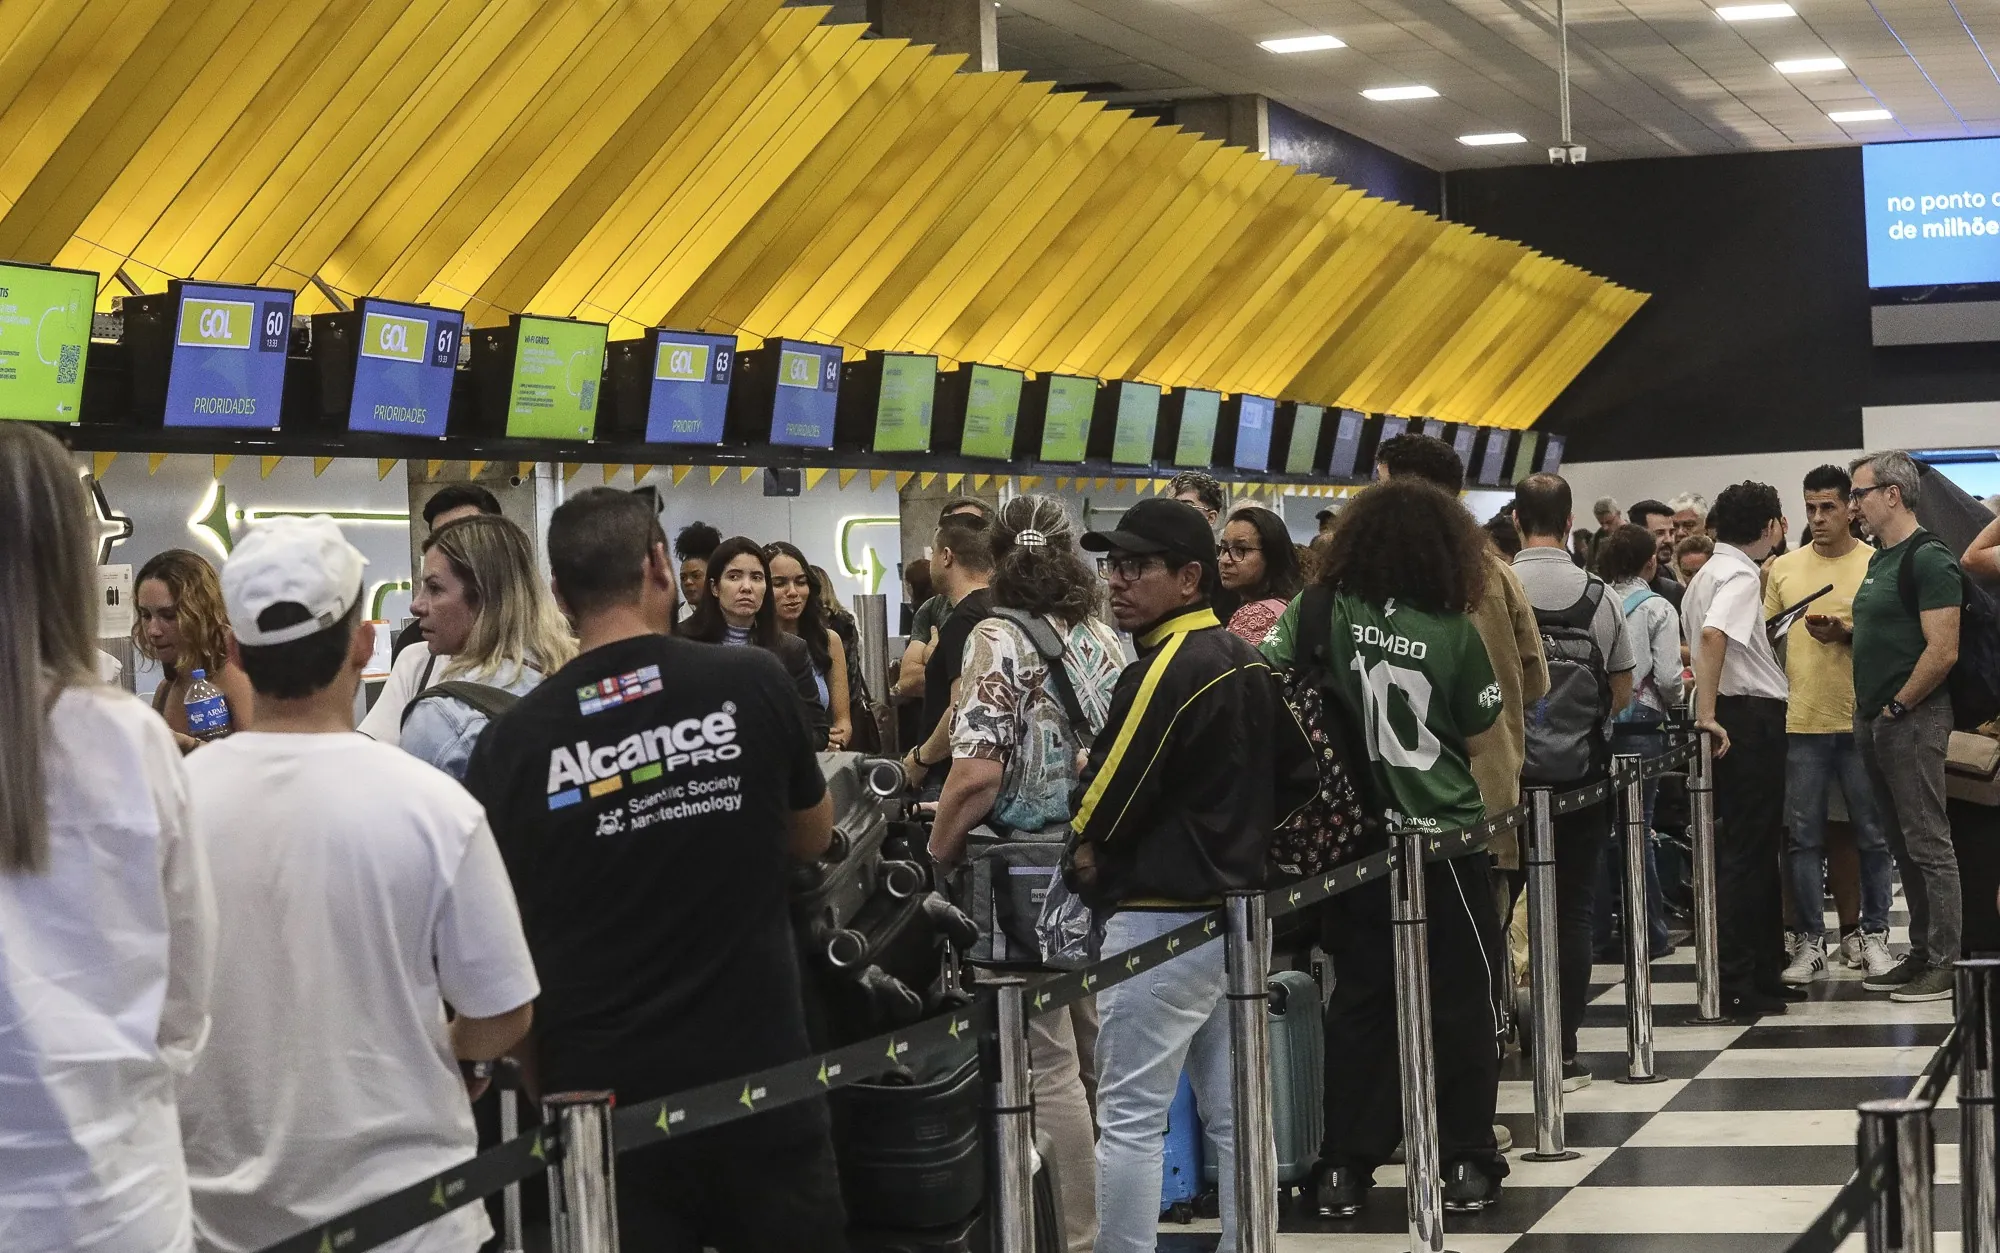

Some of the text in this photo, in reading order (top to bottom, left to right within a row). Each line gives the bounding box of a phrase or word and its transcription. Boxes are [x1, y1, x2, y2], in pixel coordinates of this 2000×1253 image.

[1887, 195, 1916, 213] no
[1920, 190, 1987, 216] ponto
[1889, 220, 1918, 240] de
[199, 308, 233, 339] GOL
[266, 311, 284, 336] 60
[379, 322, 409, 353] GOL
[438, 330, 453, 353] 61
[670, 350, 694, 374] GOL
[716, 351, 729, 372] 63
[790, 358, 809, 381] GOL
[826, 361, 837, 381] 64
[194, 397, 256, 415] PRIORIDADES
[373, 404, 427, 424] PRIORIDADES
[672, 419, 702, 433] PRIORITY
[1350, 650, 1441, 771] 10
[547, 711, 737, 794] Alcance
[665, 744, 742, 771] PRO
[687, 775, 741, 796] Society
